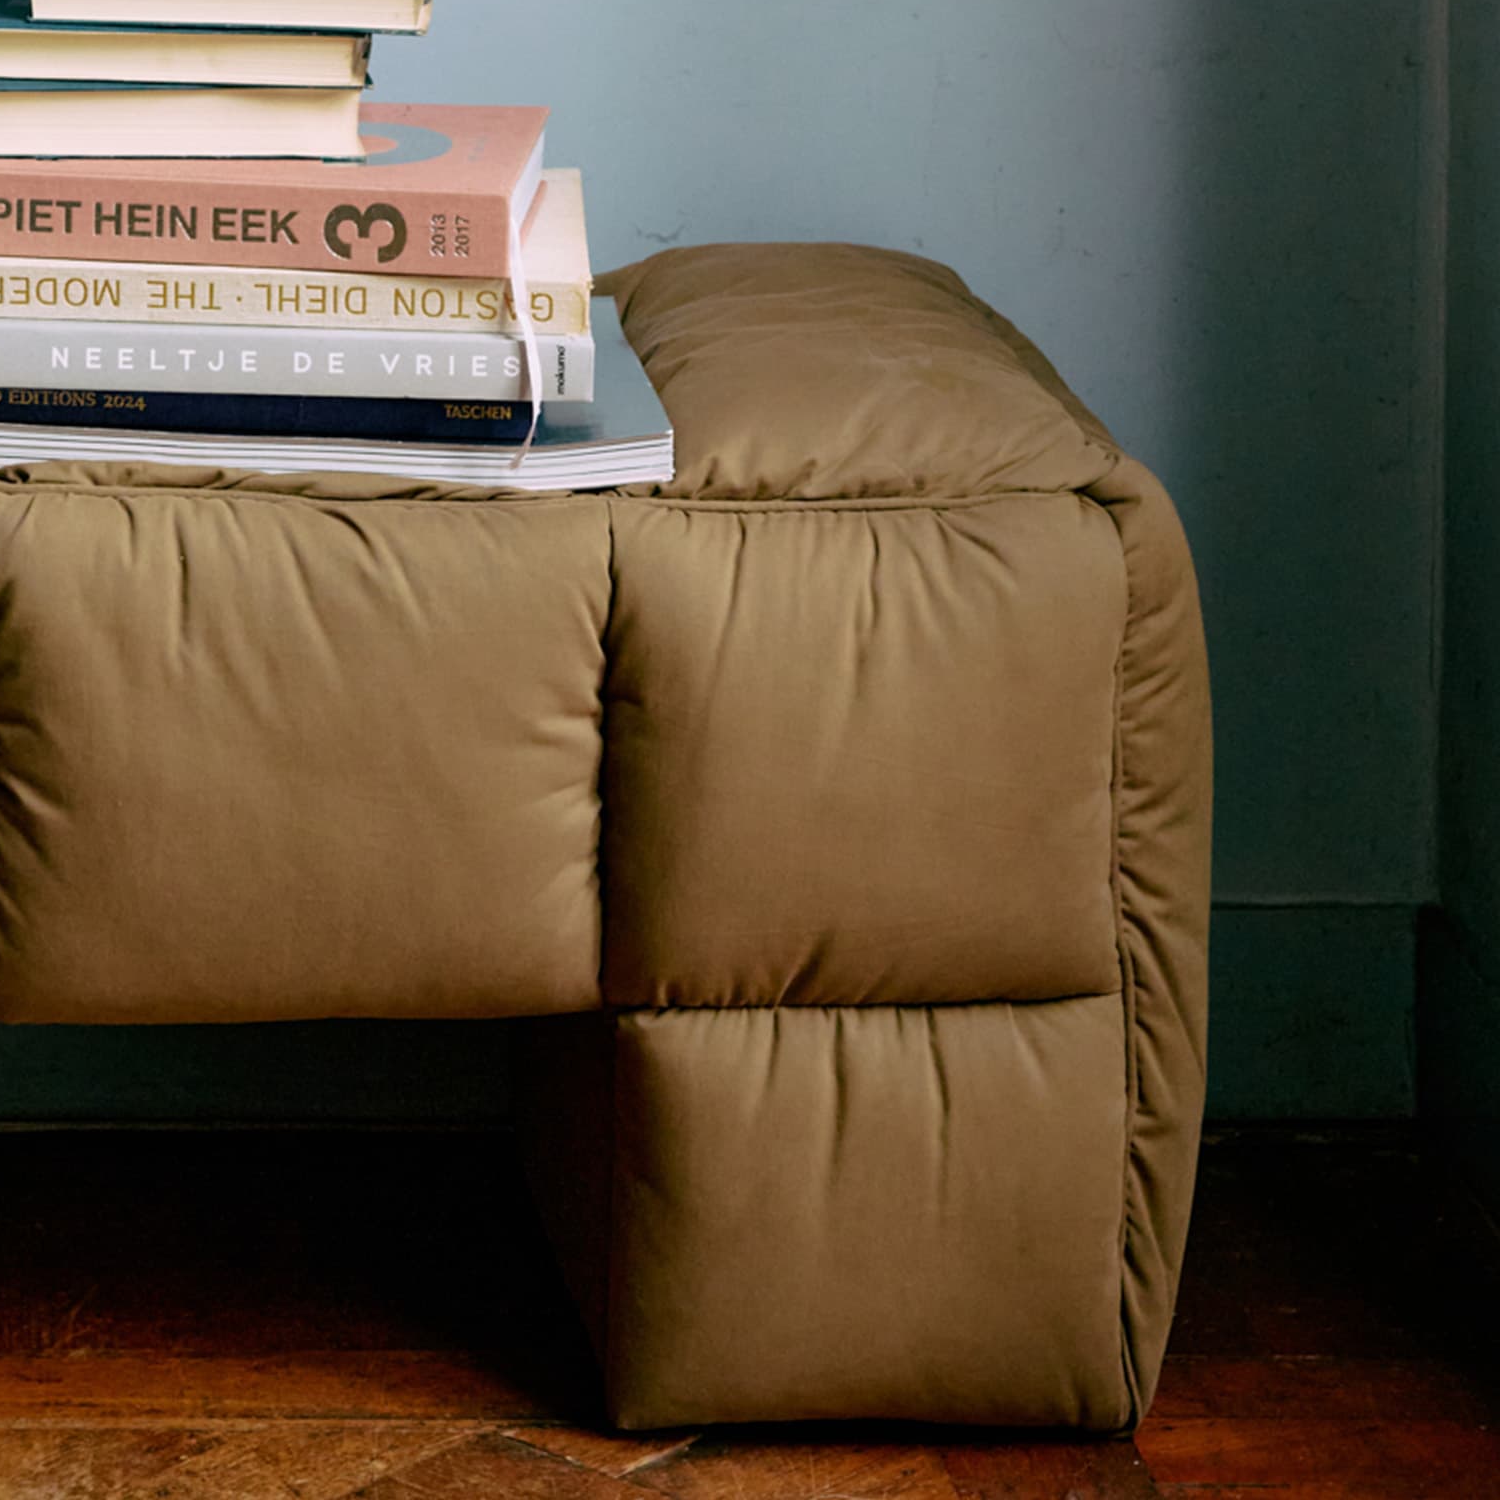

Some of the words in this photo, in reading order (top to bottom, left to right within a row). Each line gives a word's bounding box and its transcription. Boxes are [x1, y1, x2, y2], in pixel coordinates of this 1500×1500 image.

[94, 201, 198, 240] HEIN
[212, 207, 300, 245] EEK
[324, 202, 408, 263] 3
[430, 213, 446, 257] 2013
[455, 215, 470, 257] 2017
[146, 279, 223, 311] THE
[253, 283, 368, 315] DIEHL
[51, 347, 258, 373] NEELTJE
[293, 351, 346, 374] DE
[380, 353, 521, 378] VRIES
[8, 388, 97, 407] EDITIONS
[103, 394, 147, 412] 2024
[444, 403, 513, 420] TASCHEN
